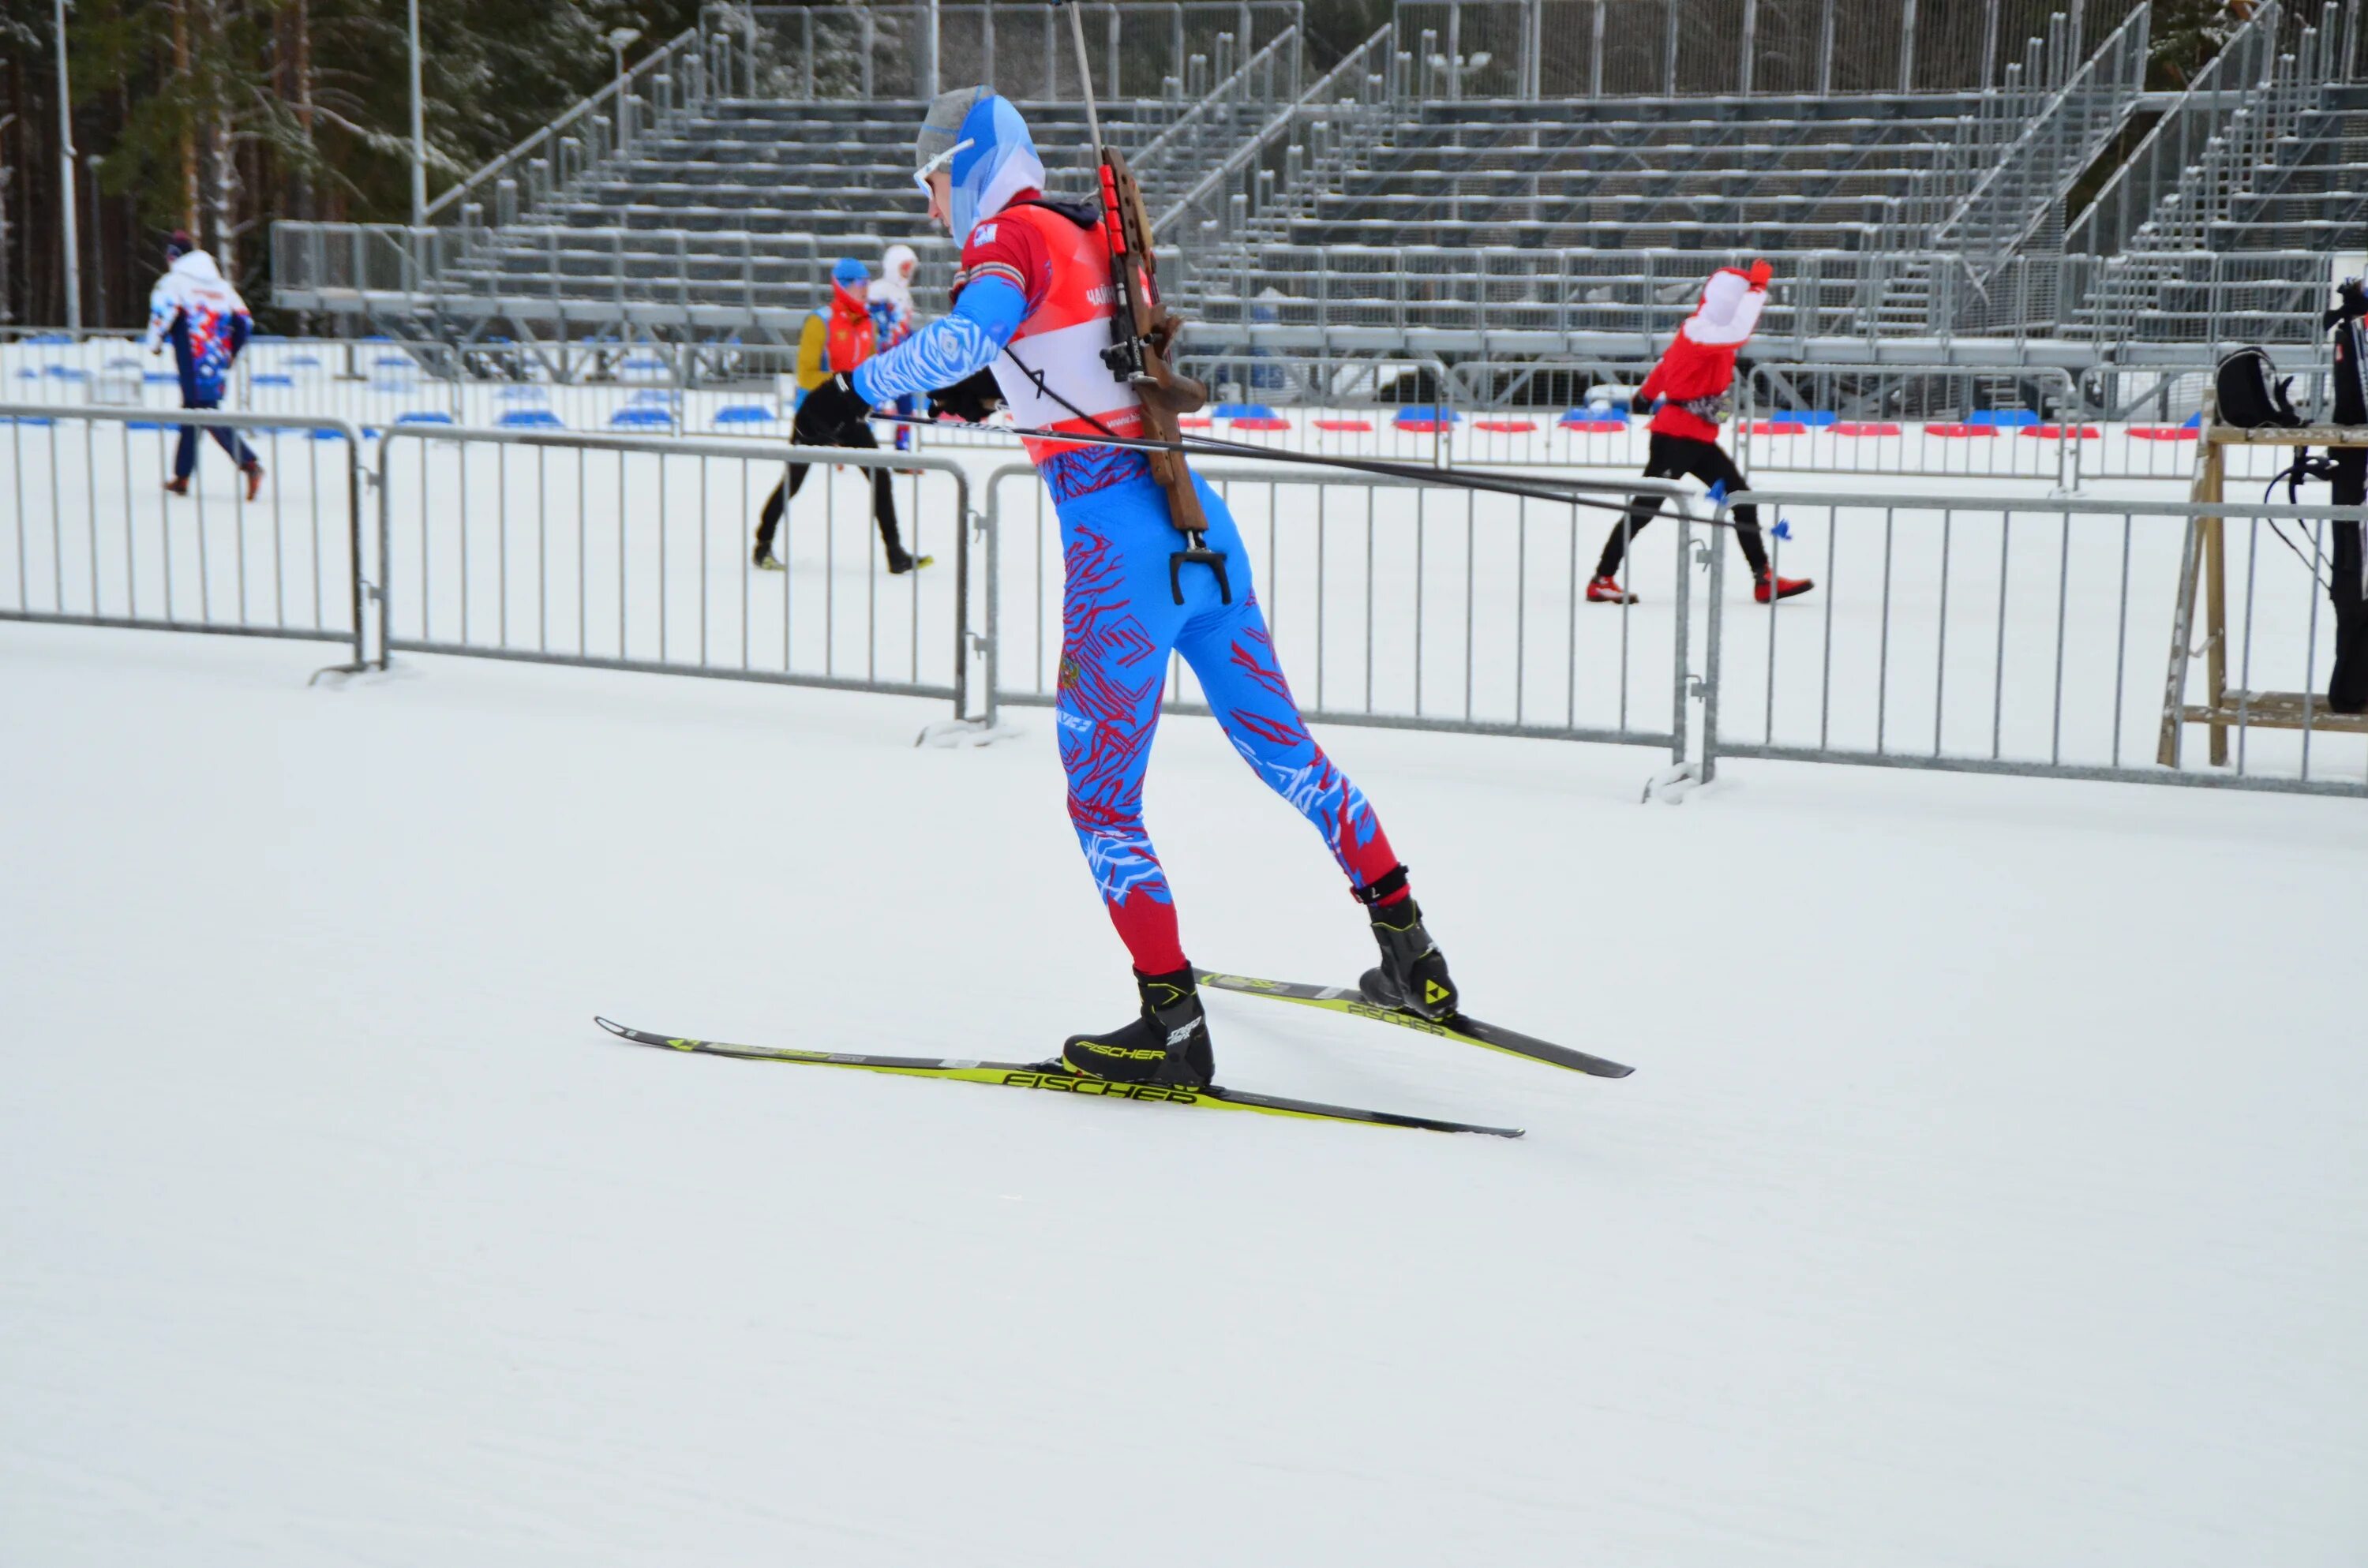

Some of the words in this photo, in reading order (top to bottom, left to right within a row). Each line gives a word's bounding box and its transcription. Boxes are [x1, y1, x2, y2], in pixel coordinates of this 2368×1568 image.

[1347, 1003, 1445, 1037] FISCHER
[1074, 1040, 1167, 1061] FISCHER
[1002, 1072, 1198, 1105] FISCHER
